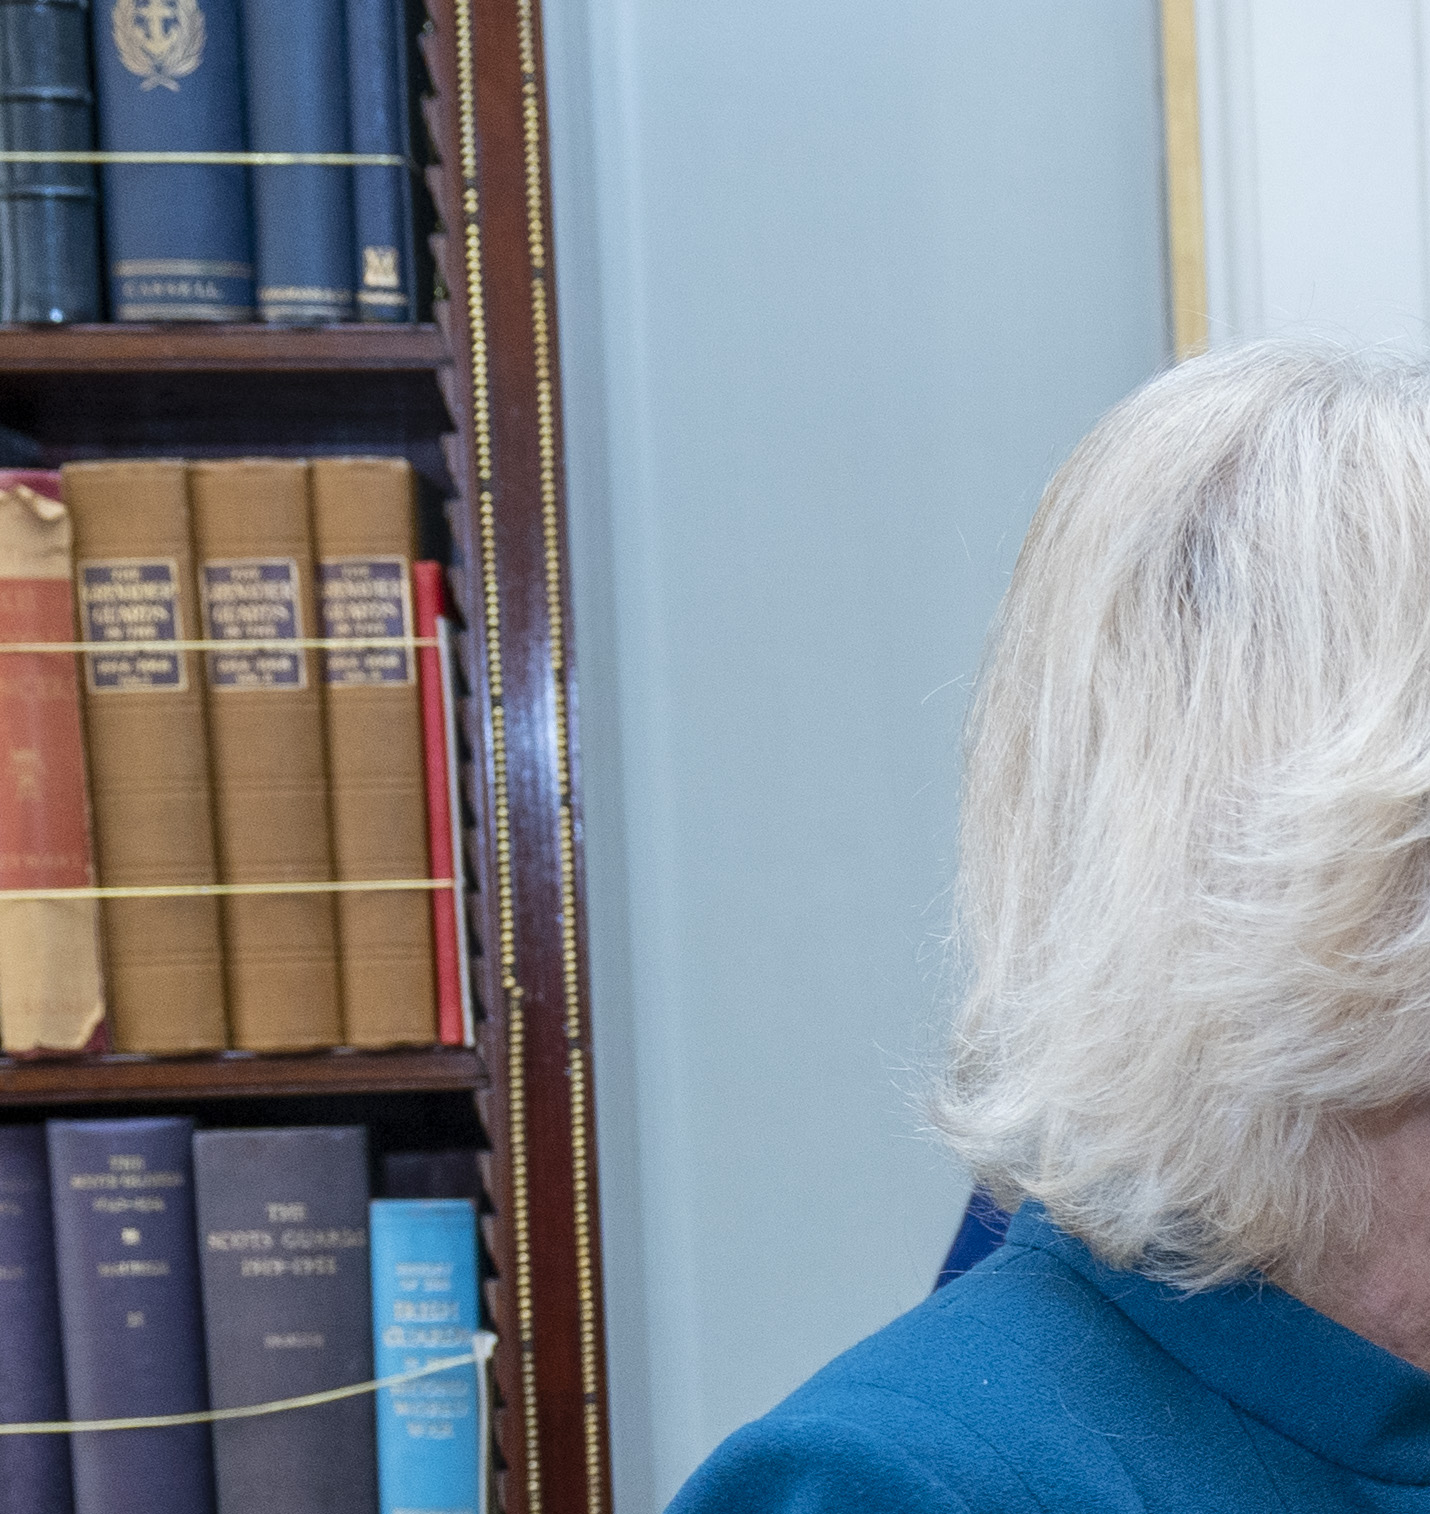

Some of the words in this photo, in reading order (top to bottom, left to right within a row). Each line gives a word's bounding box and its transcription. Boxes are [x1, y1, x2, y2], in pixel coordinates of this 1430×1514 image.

[267, 1202, 306, 1222] THE
[207, 1230, 273, 1250] SCOTS
[280, 1228, 365, 1249] GUARDS
[393, 1301, 460, 1322] IRISH
